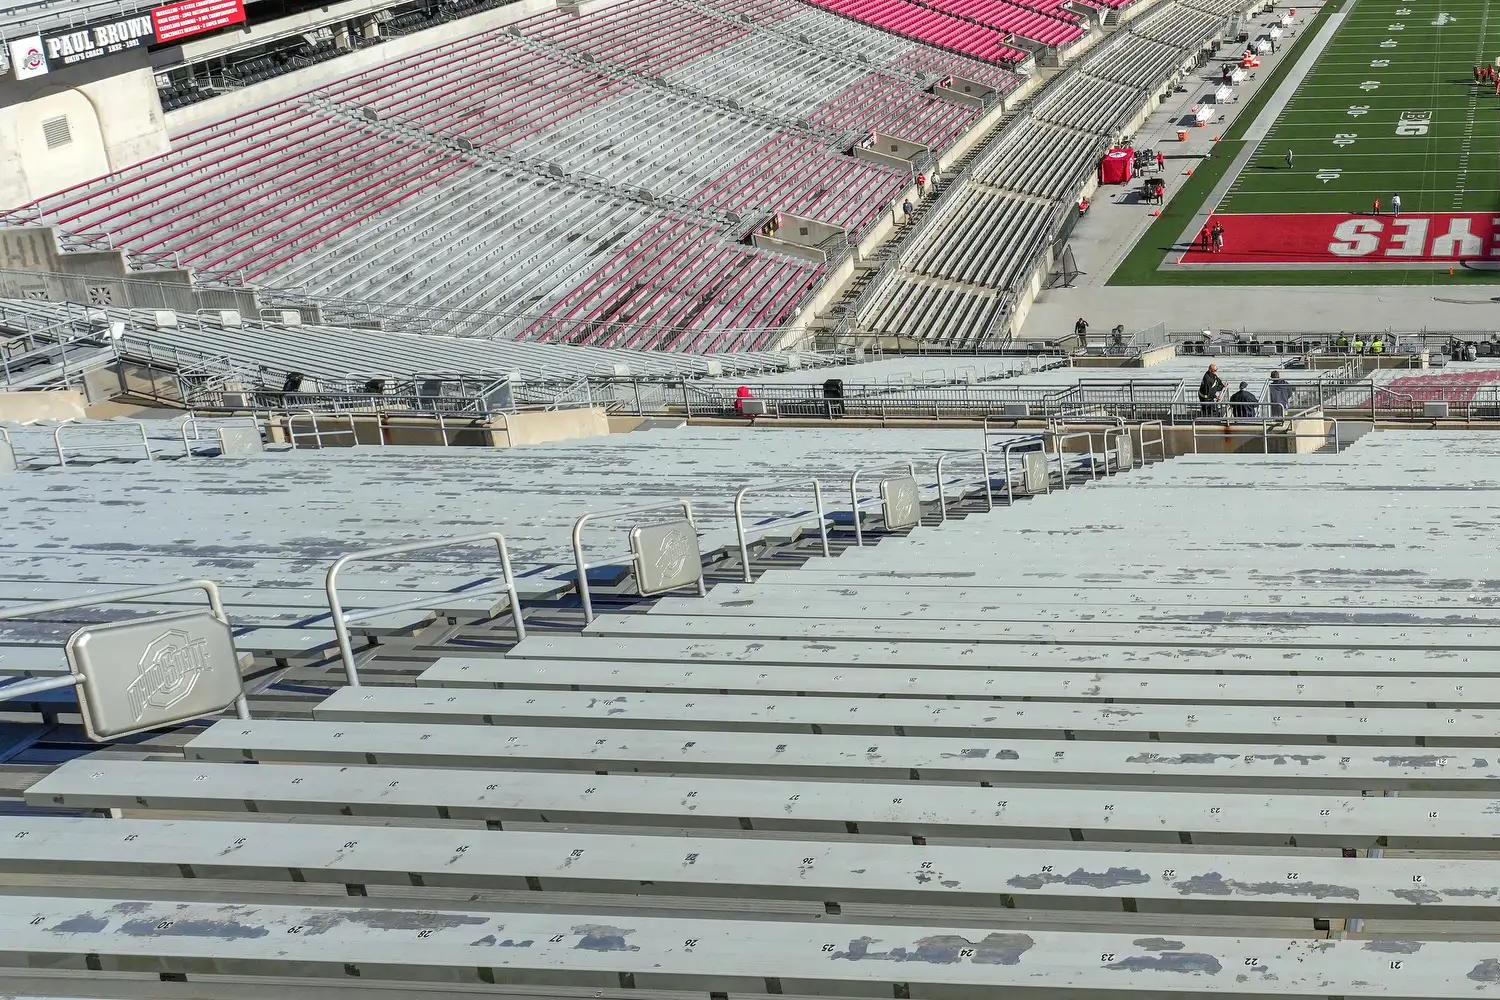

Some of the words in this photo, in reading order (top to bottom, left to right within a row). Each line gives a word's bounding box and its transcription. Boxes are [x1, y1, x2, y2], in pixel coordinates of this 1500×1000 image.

[46, 30, 94, 59] PAUL
[92, 15, 154, 47] BROWN
[85, 48, 104, 59] COACH
[1333, 134, 1358, 144] 20
[1316, 169, 1342, 179] 10
